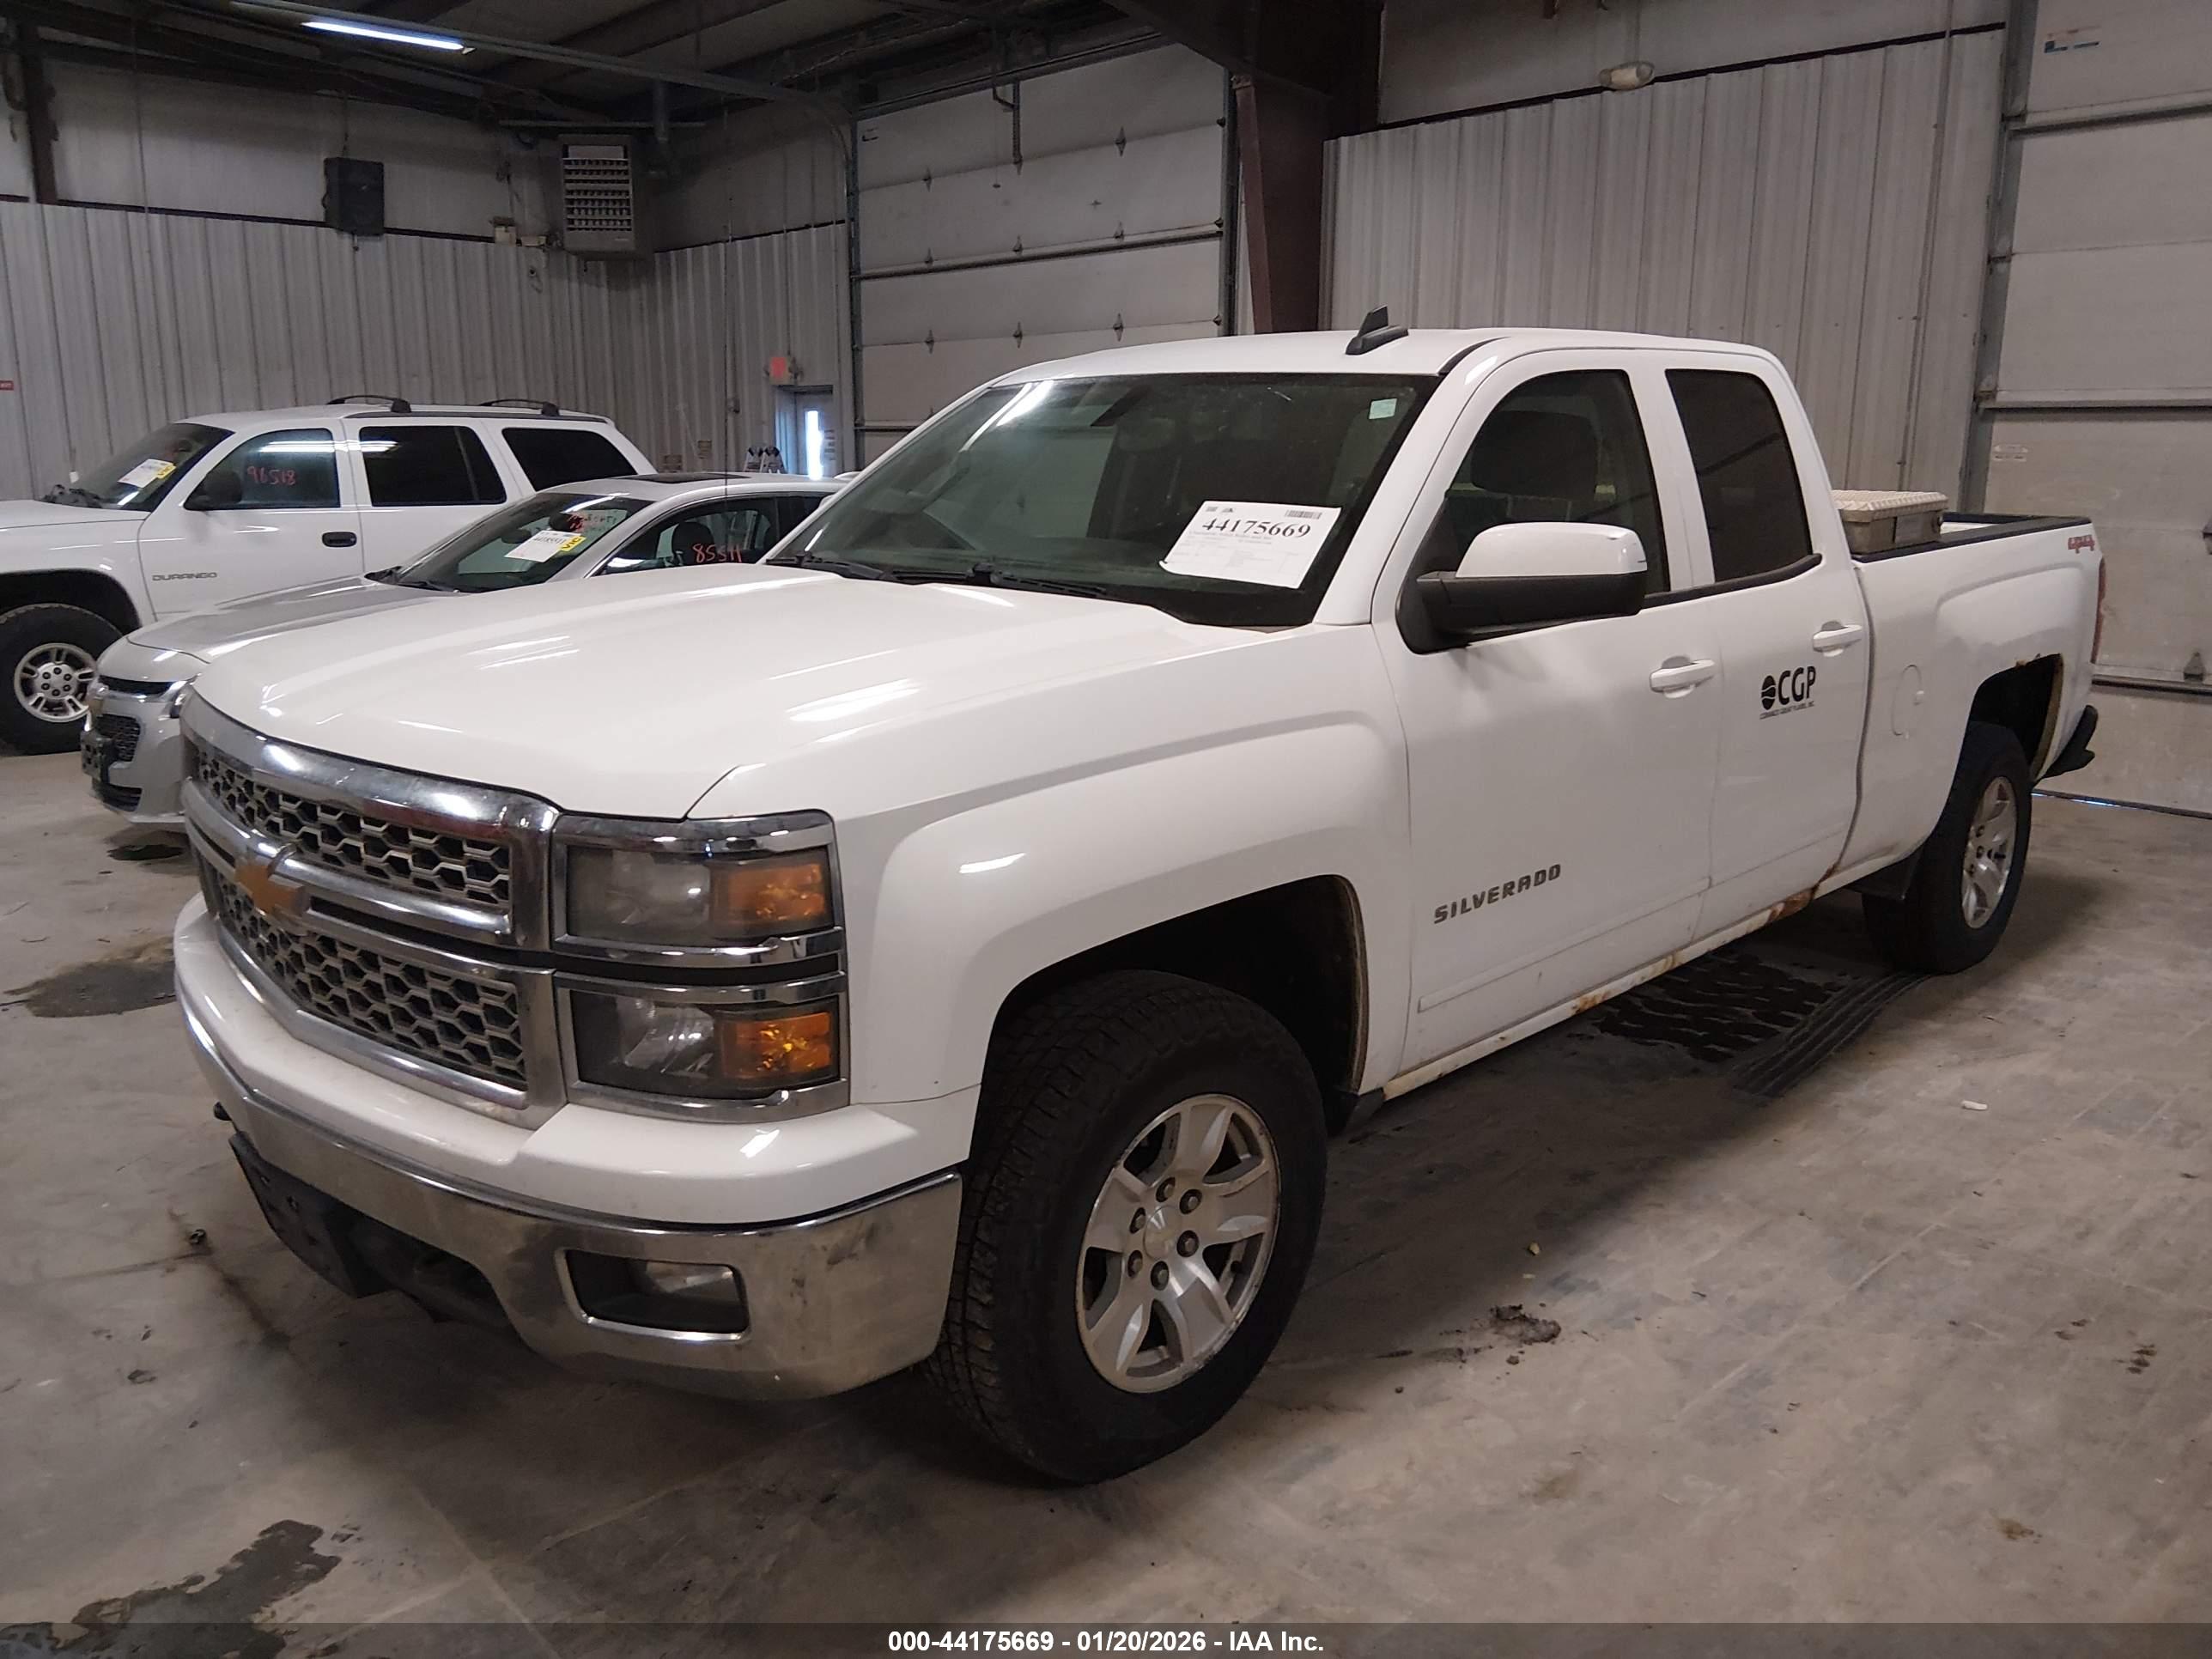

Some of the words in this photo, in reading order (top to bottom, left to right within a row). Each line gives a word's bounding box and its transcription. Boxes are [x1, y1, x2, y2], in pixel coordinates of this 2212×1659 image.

[1202, 518, 1311, 538] 44175669
[152, 572, 217, 581] DURANGO
[1778, 665, 1816, 705] CGP
[1433, 864, 1561, 924] SILVERADO
